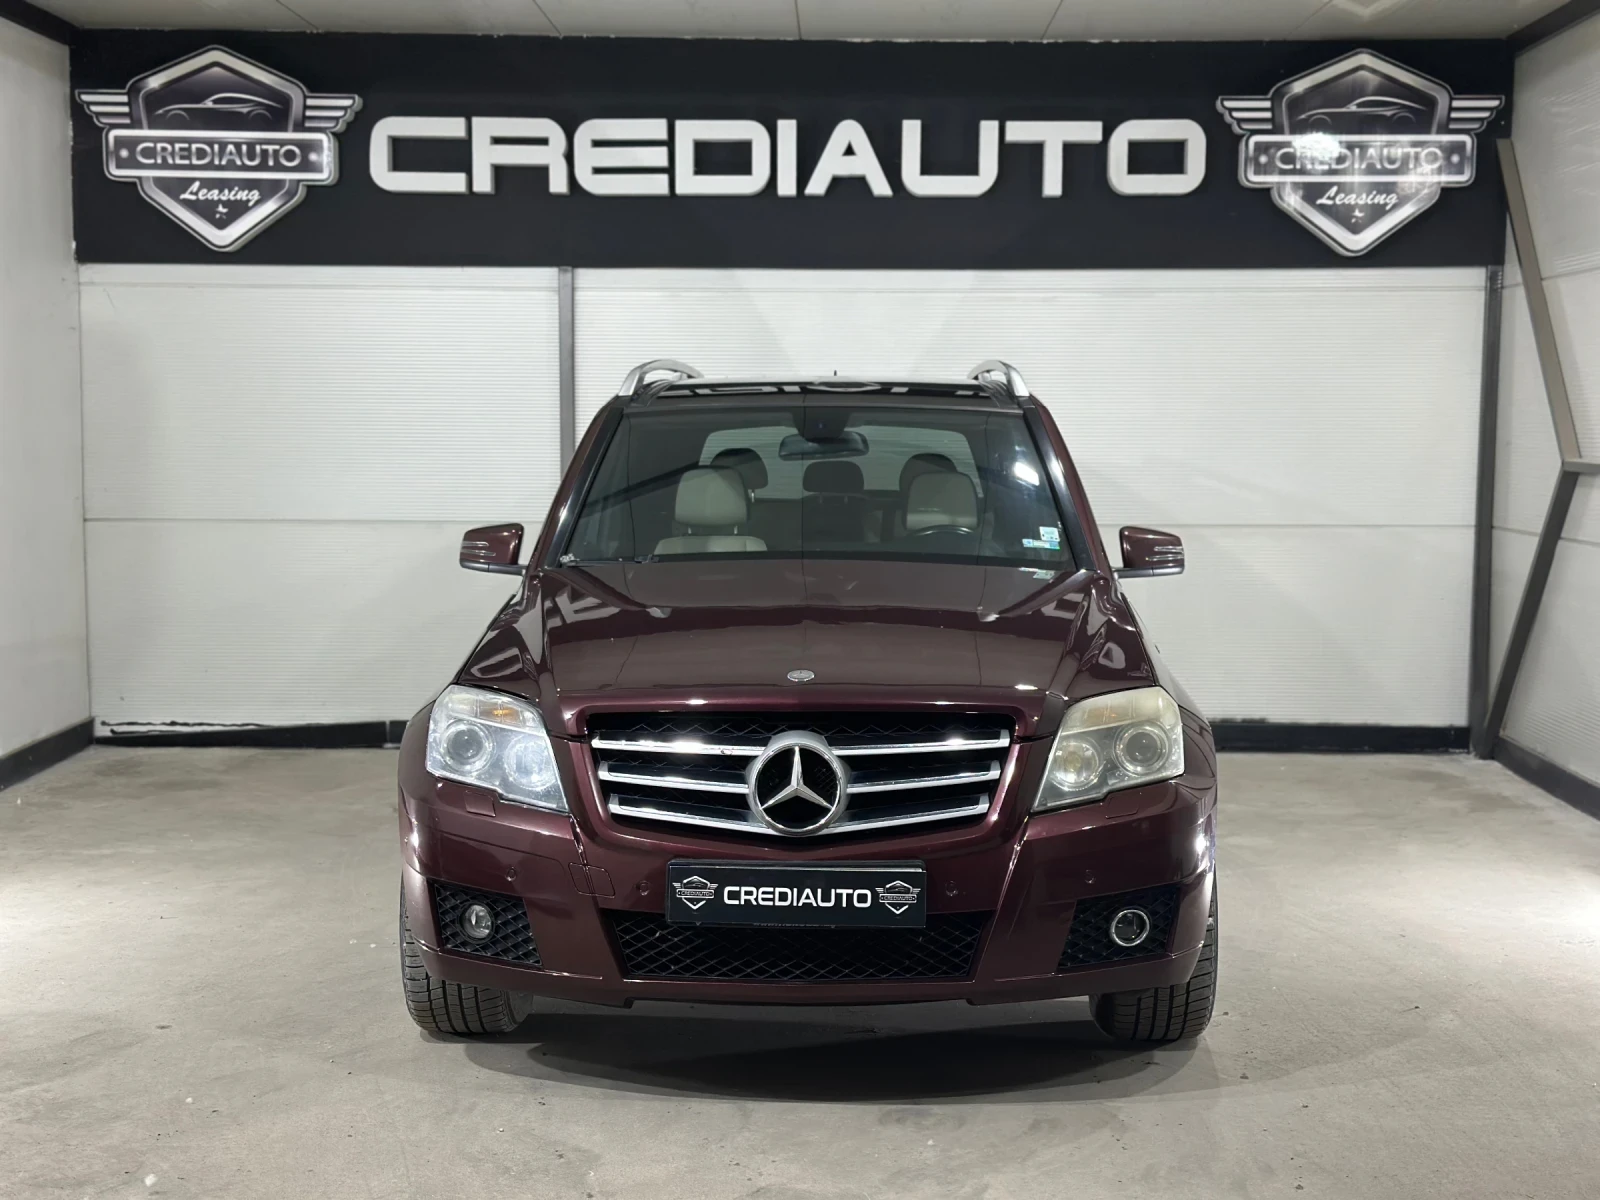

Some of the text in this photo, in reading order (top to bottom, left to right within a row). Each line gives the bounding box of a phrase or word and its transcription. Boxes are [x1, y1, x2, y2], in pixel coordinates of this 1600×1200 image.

[135, 142, 302, 167] CREDIAUTO
[369, 115, 1206, 197] CREDIAUTO
[179, 181, 261, 206] Leasing
[1316, 186, 1399, 210] Leasing
[723, 885, 872, 908] CREDIAUTO
